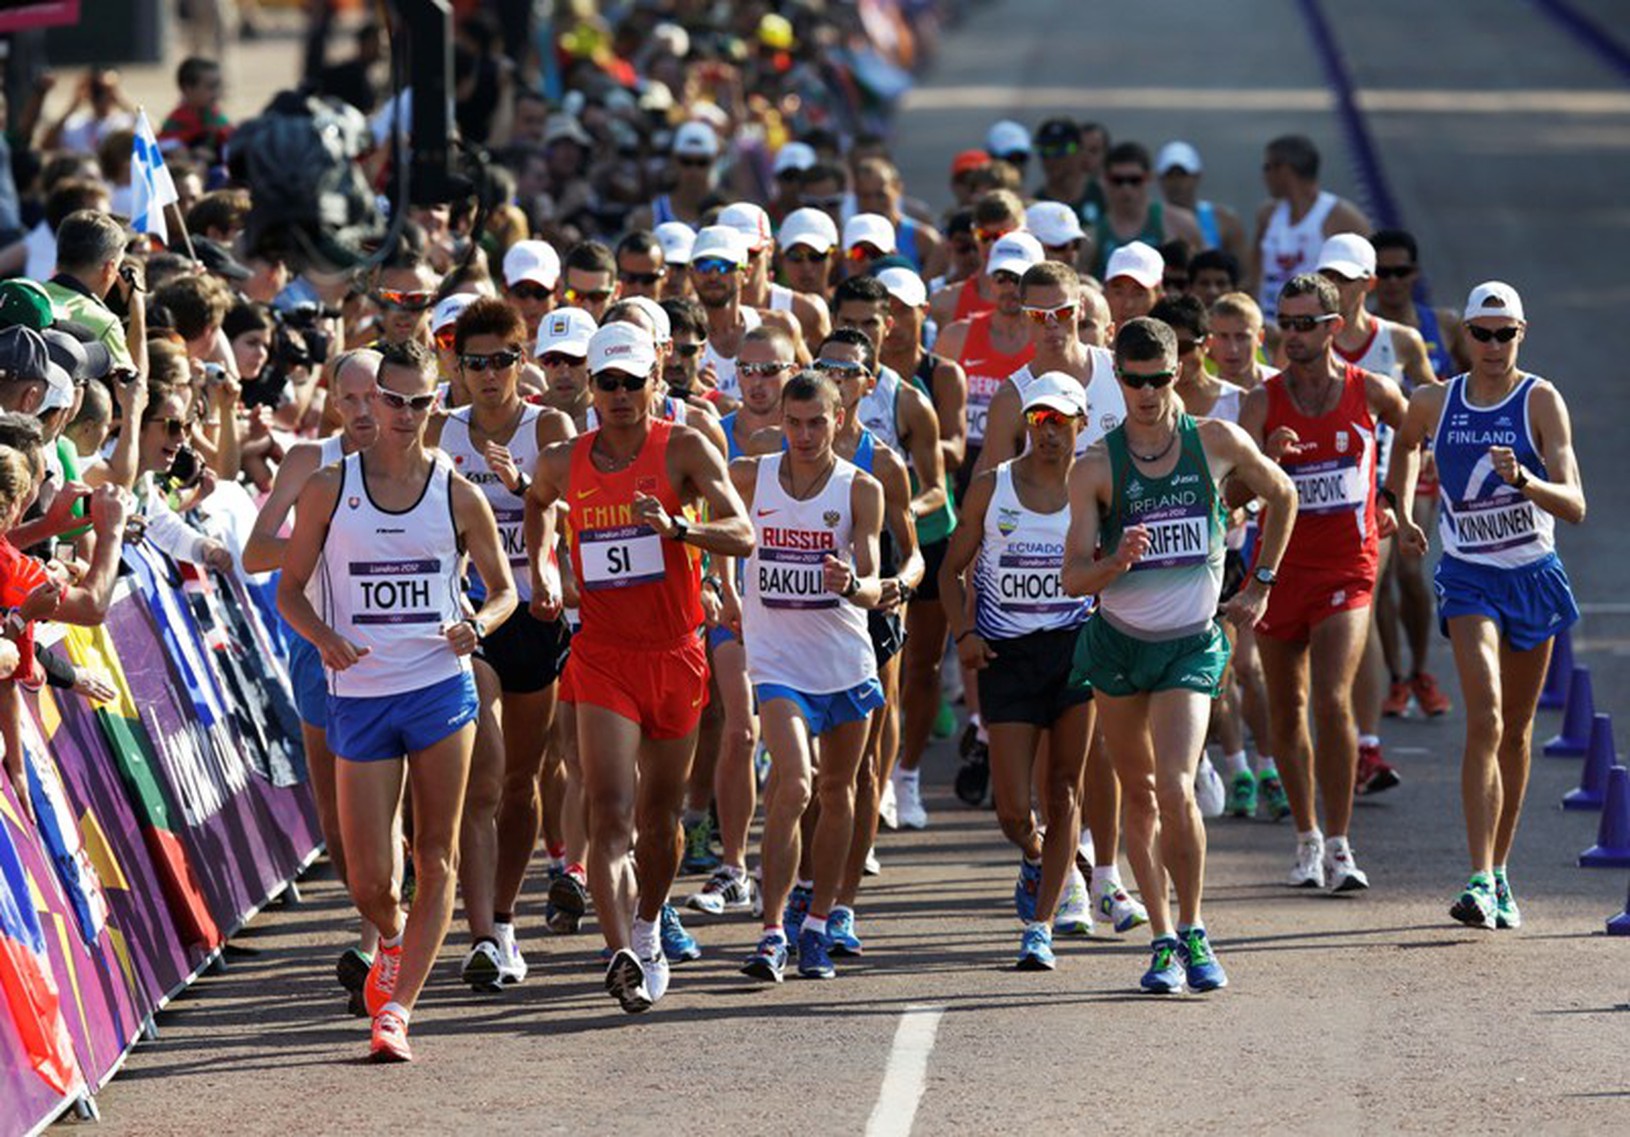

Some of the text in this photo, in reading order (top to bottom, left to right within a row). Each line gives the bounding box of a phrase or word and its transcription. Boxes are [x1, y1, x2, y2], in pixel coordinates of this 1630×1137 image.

[1447, 431, 1517, 444] FINLAND
[1130, 490, 1197, 514] IRELAND
[762, 527, 834, 550] RUSSIA
[1457, 506, 1535, 542] KINNUNEN
[607, 545, 631, 575] SI
[360, 580, 429, 609] TOTH
[760, 566, 828, 595] BAKULI
